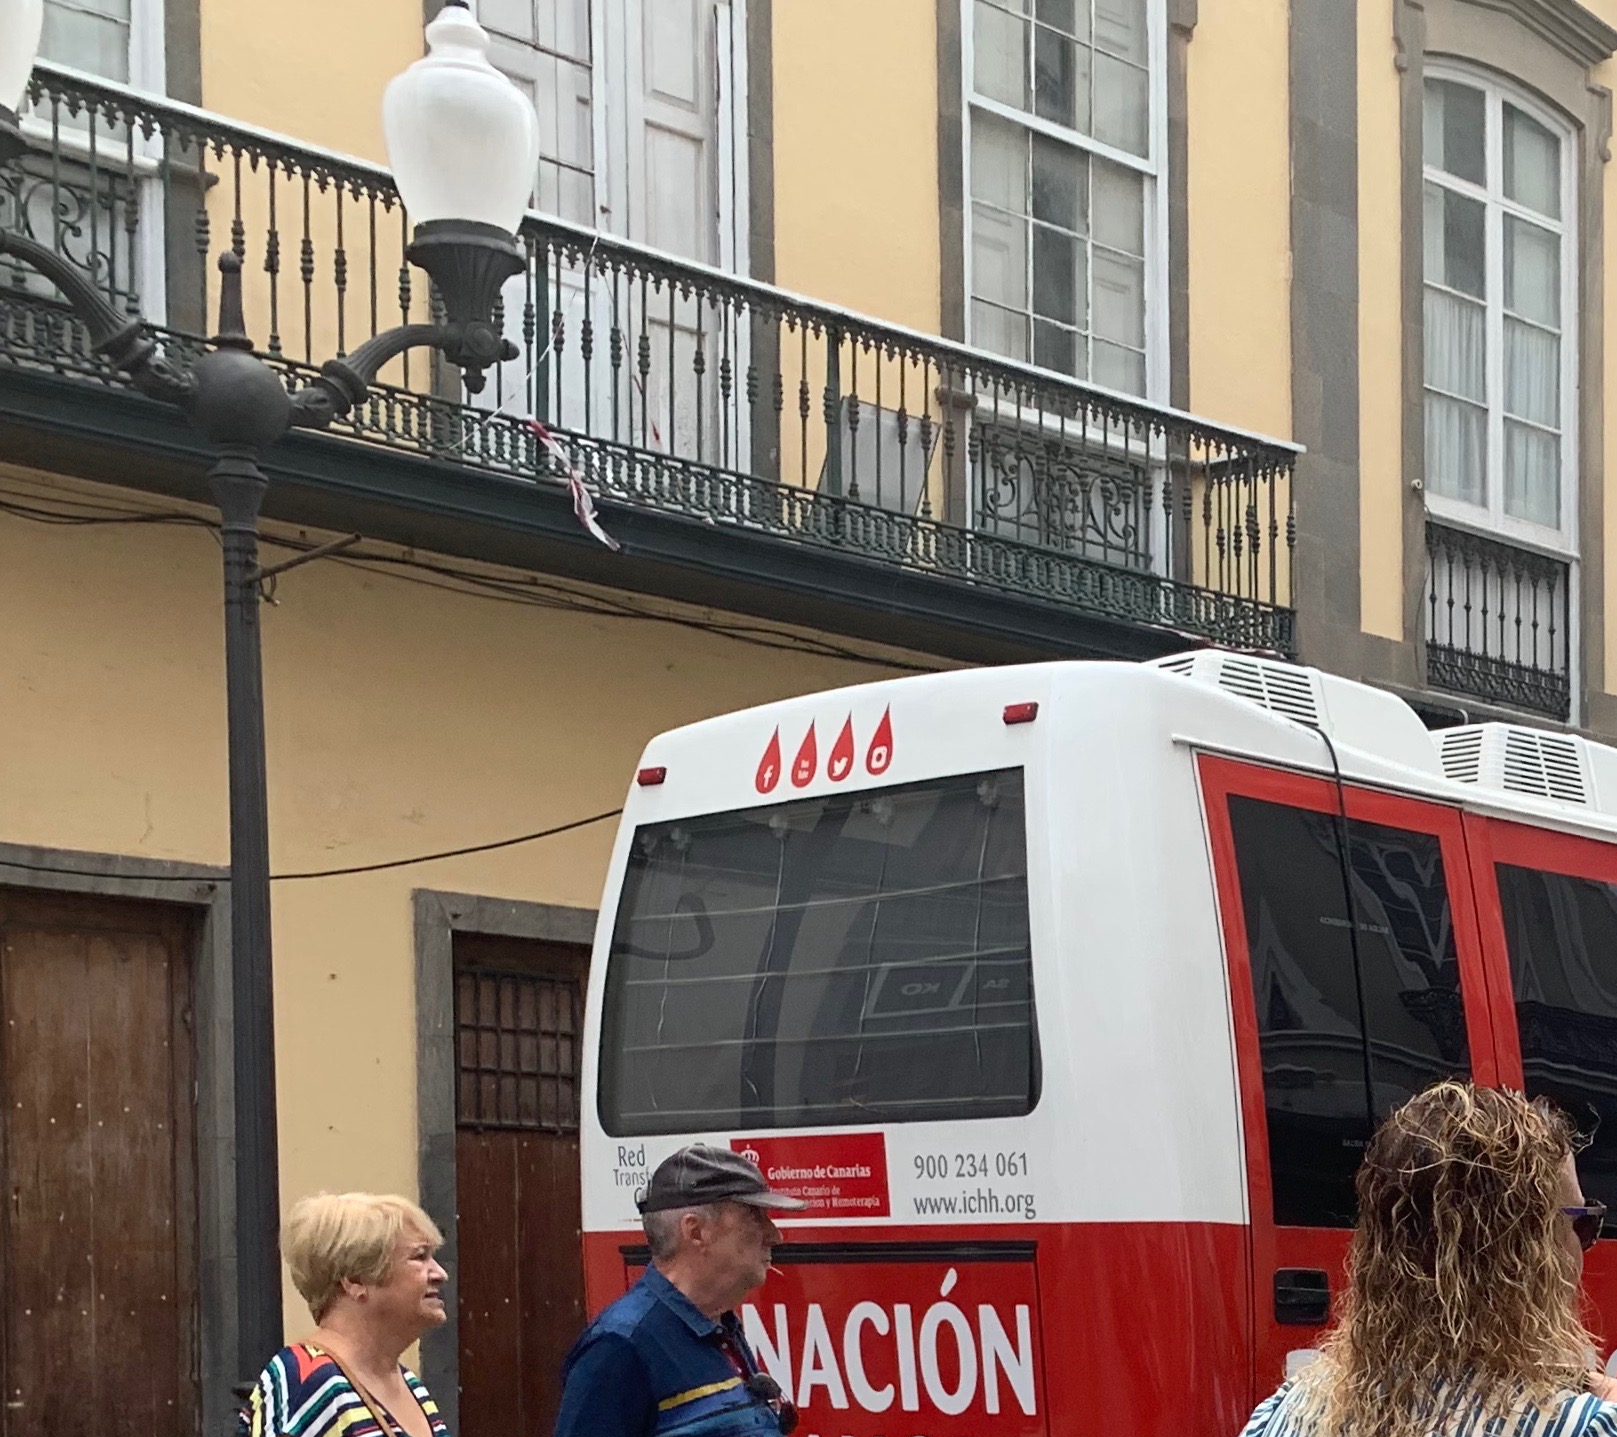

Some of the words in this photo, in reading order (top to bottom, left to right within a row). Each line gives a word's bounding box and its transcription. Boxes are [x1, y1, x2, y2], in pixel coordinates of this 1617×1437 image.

[617, 1143, 646, 1168] Red
[913, 1154, 948, 1179] 900
[954, 1153, 988, 1178] 234
[995, 1151, 1027, 1177] 061
[767, 1166, 813, 1181] Gobierno
[813, 1164, 826, 1178] de
[826, 1163, 871, 1178] Canarias
[913, 1187, 1037, 1220] www.ichh.org
